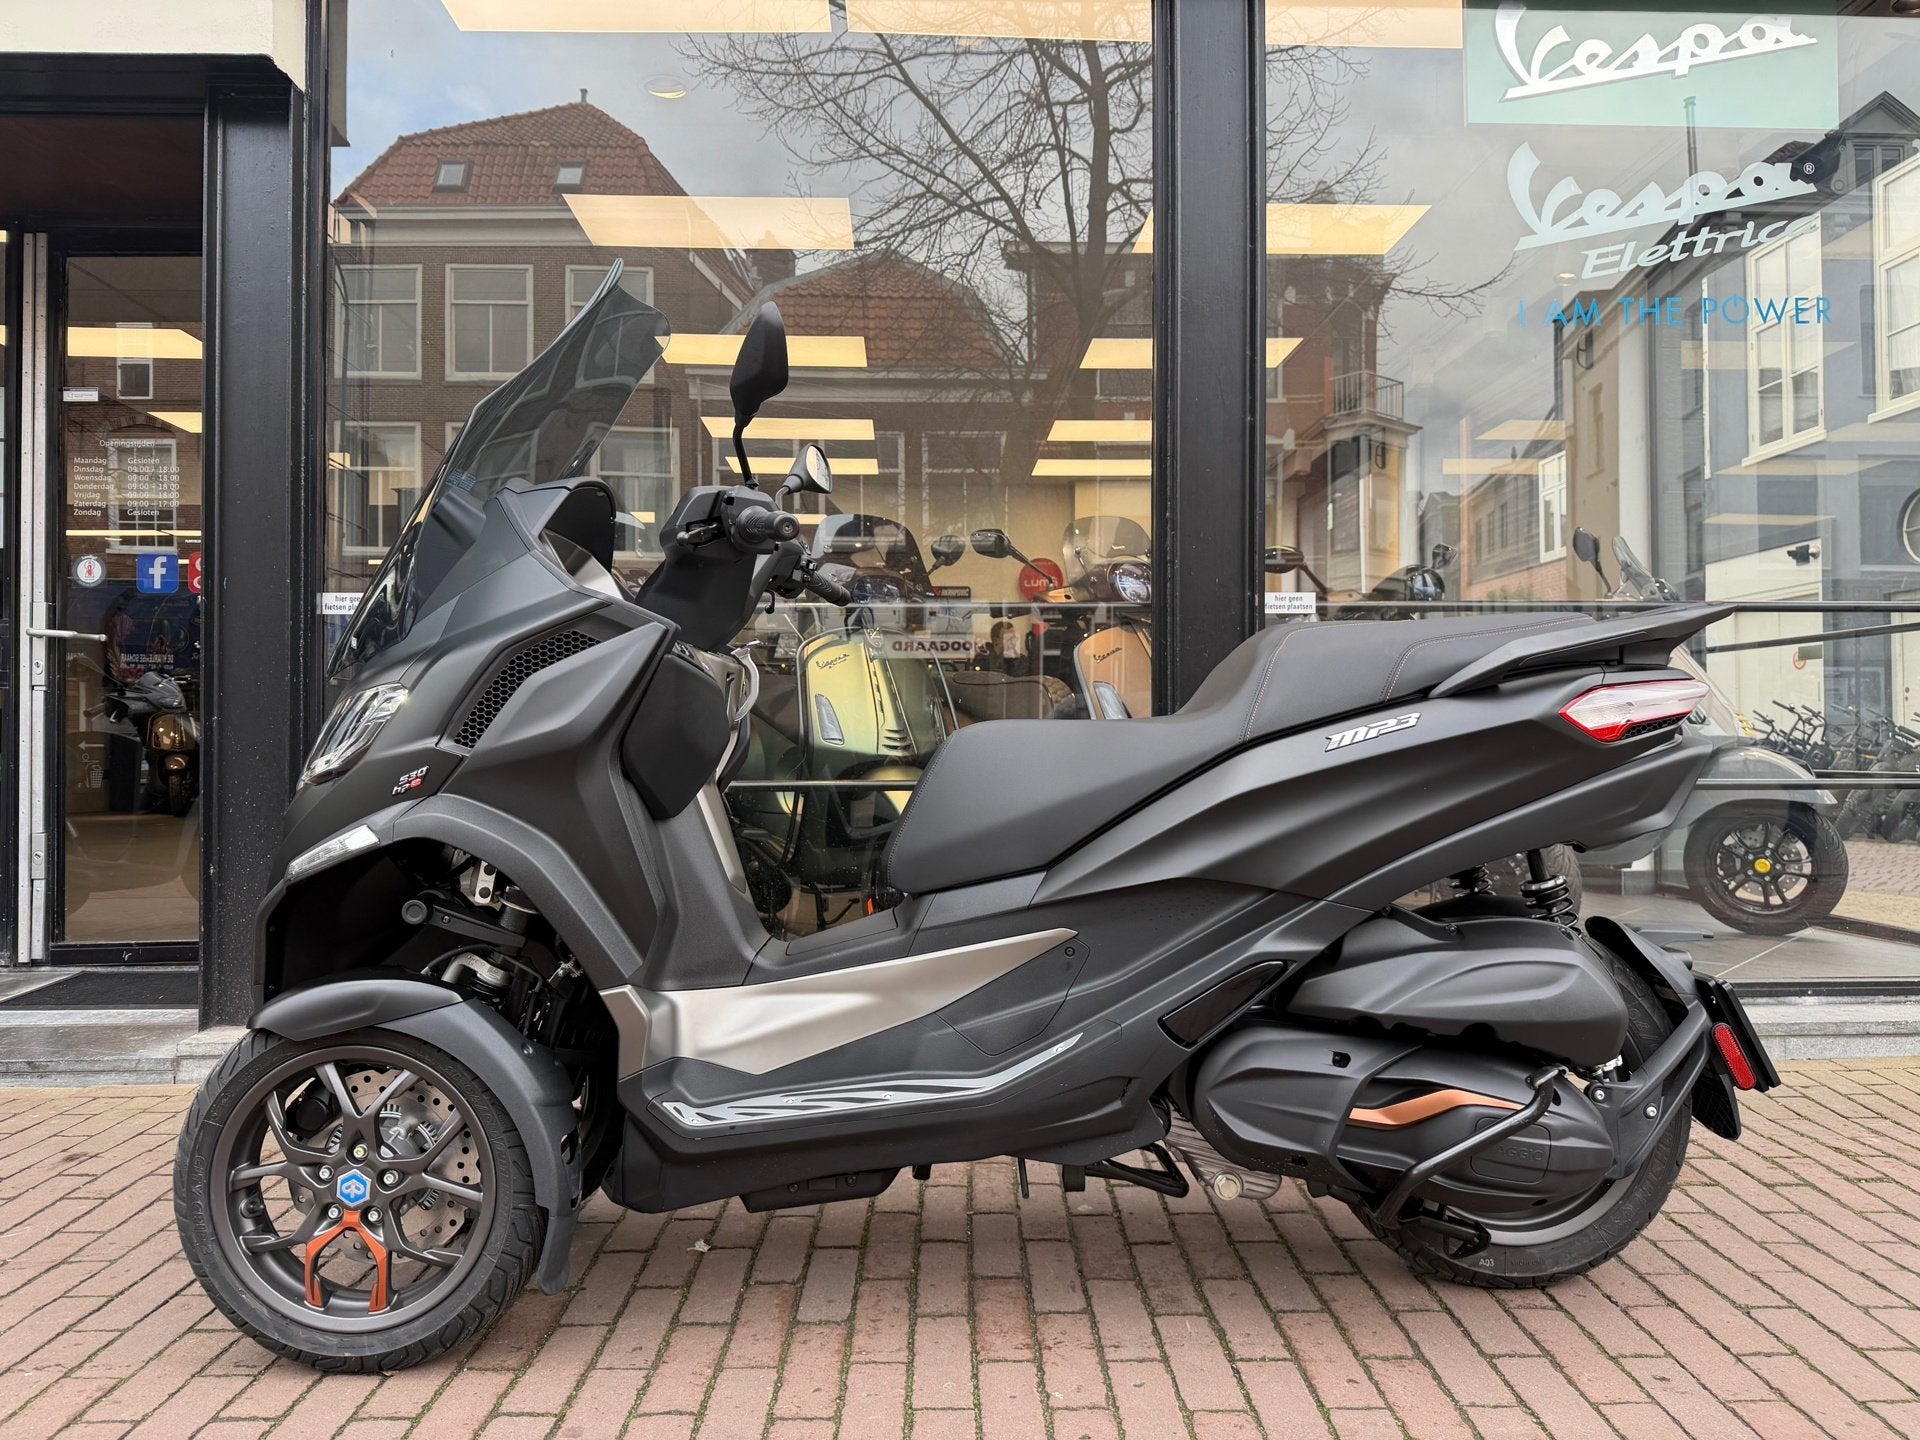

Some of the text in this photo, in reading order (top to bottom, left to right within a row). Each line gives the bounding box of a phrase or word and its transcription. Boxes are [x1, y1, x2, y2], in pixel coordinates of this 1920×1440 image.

[1495, 3, 1817, 100] Vespa
[1507, 141, 1818, 250] Vespa
[1581, 214, 1820, 279] Elettrica
[1518, 293, 1833, 328] I AM THE POWER
[99, 440, 155, 448] Openingstijden
[324, 603, 347, 611] fietsen
[1287, 603, 1313, 611] plaatsen
[1324, 712, 1421, 752] MP3
